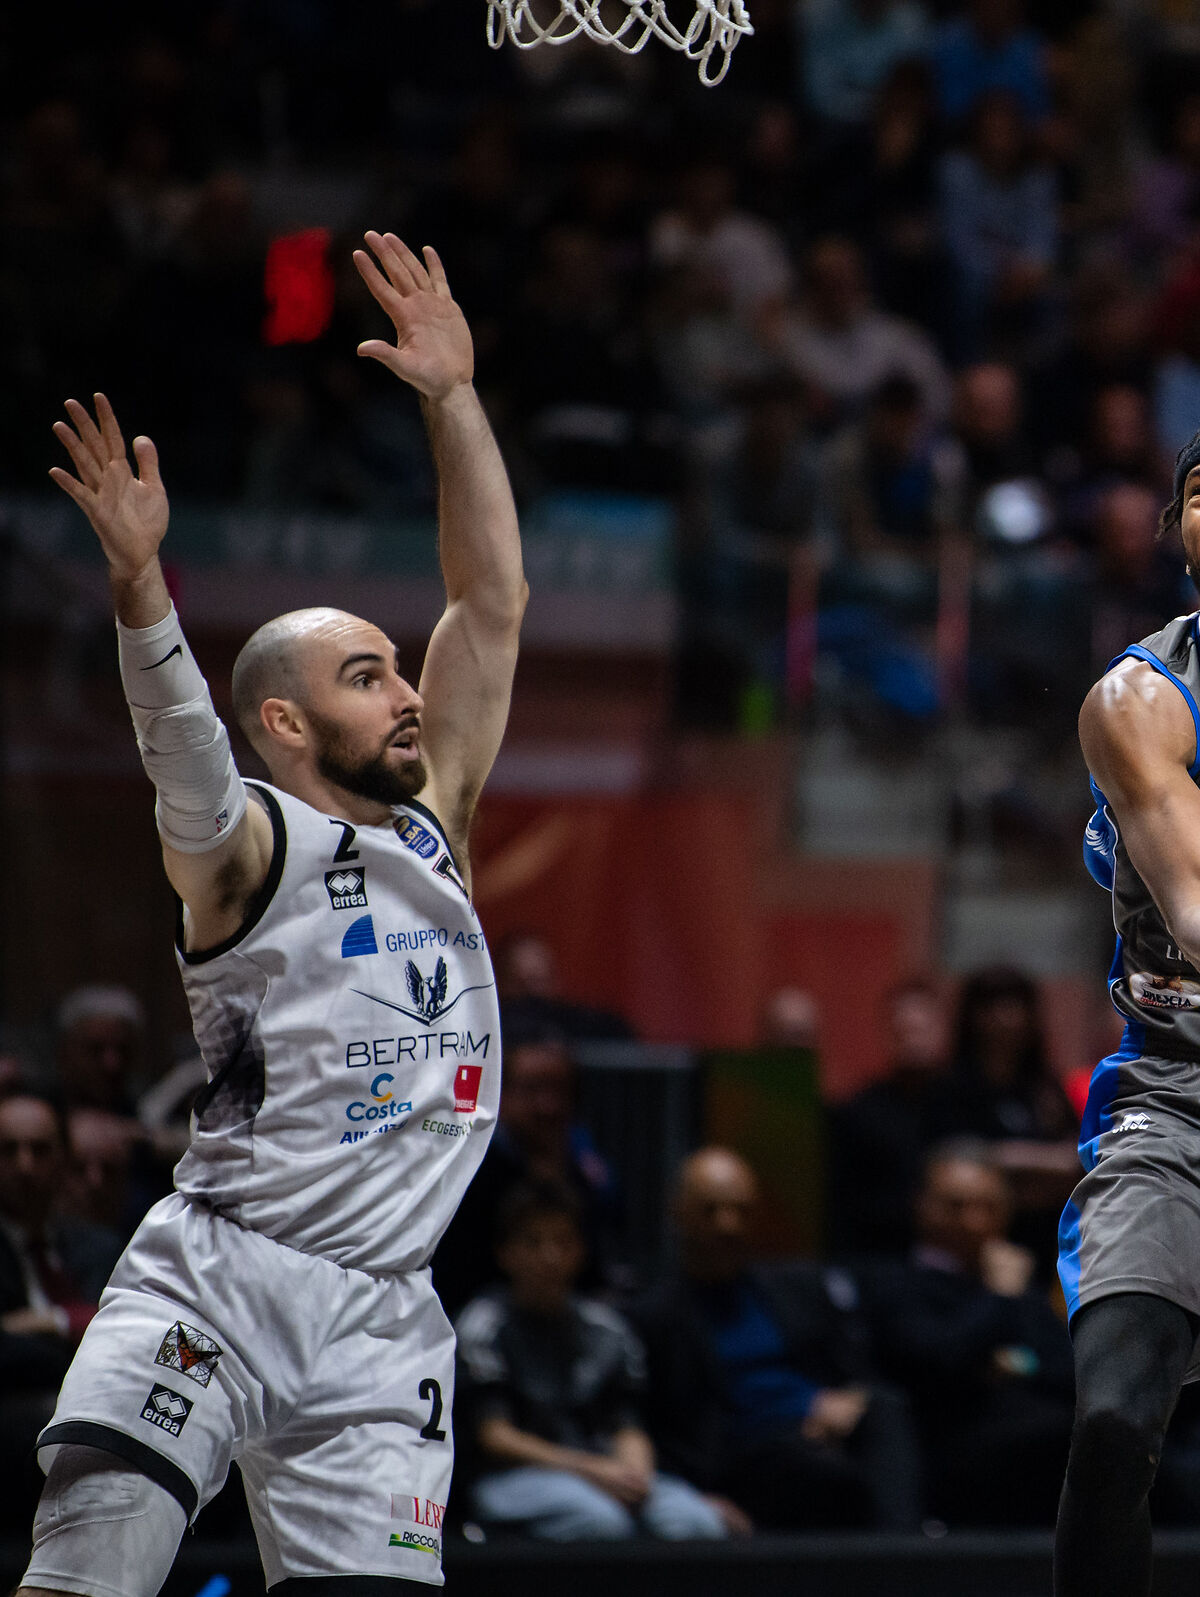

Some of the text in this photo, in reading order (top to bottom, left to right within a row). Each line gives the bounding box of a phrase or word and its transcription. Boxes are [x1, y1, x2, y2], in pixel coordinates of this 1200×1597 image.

[328, 818, 360, 863] 2
[386, 928, 448, 952] GRUPPO
[346, 1031, 490, 1068] BERTRAM
[346, 1100, 412, 1122] Costa
[418, 1378, 446, 1441] 2
